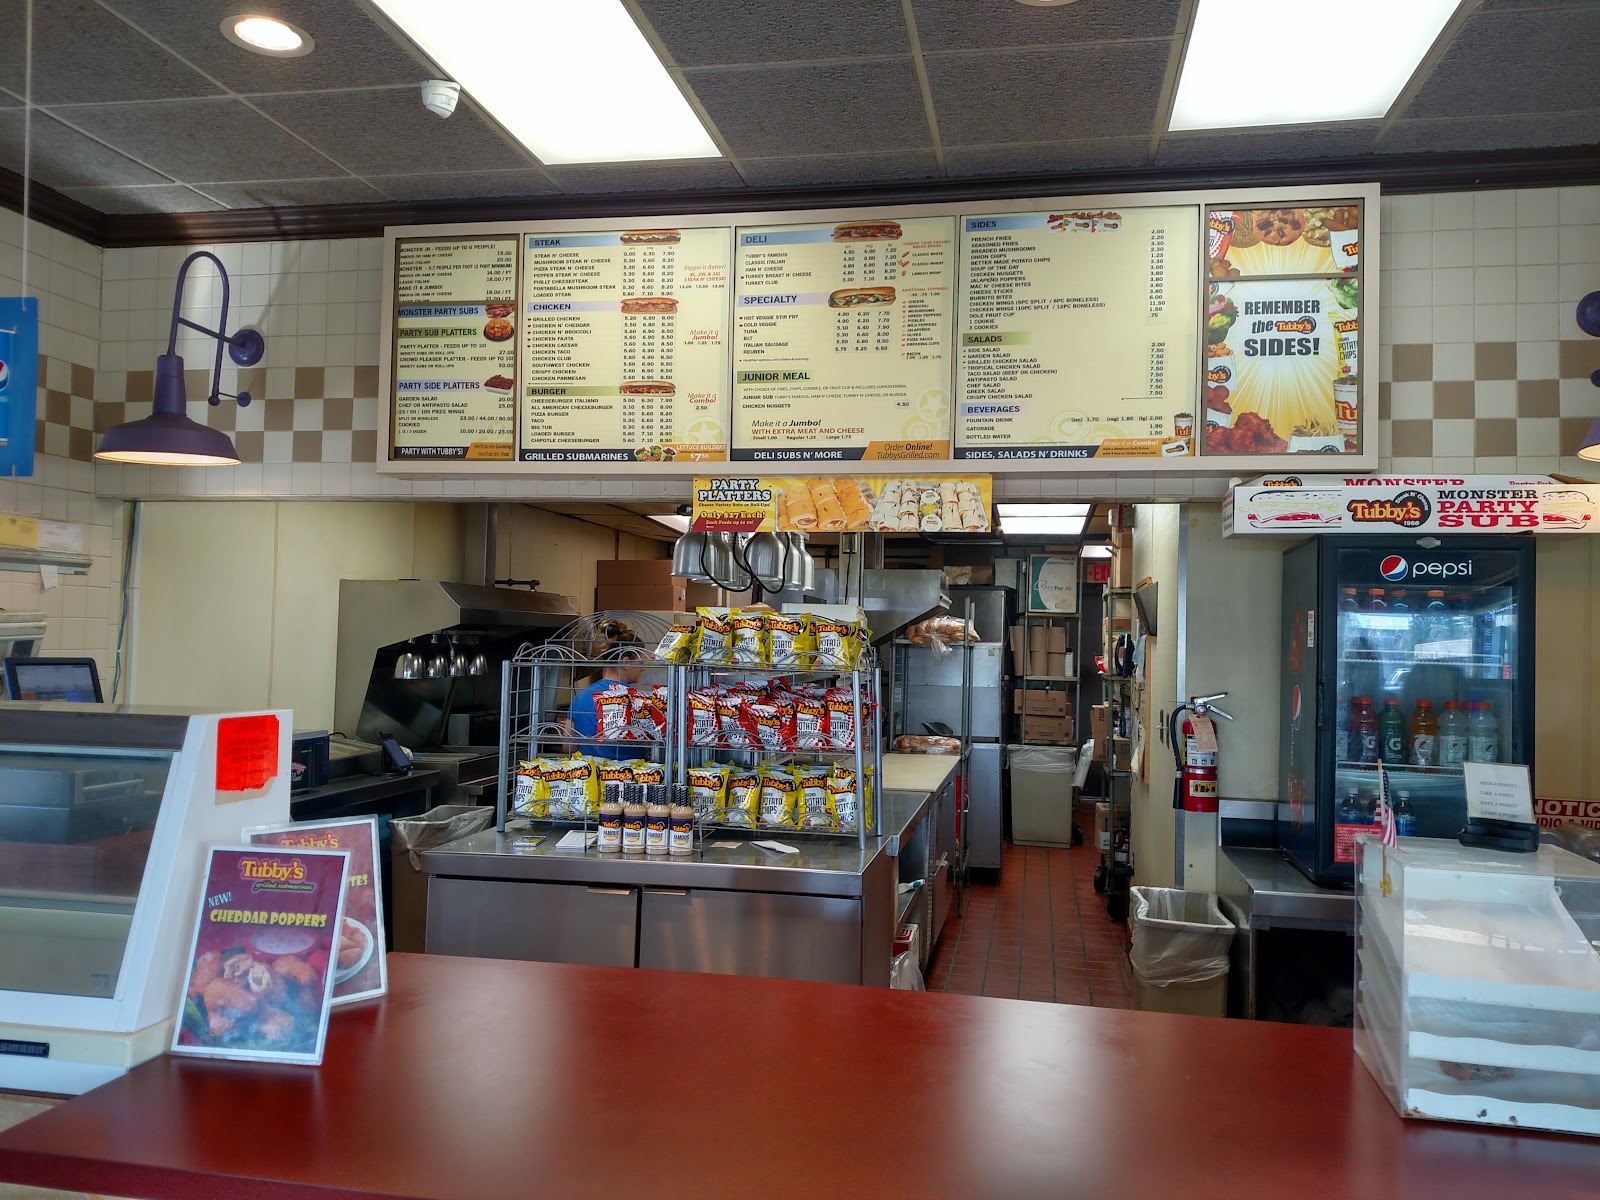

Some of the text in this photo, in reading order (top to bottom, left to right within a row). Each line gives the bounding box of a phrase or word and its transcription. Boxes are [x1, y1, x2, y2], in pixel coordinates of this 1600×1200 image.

[971, 220, 997, 229] SIDES
[745, 235, 767, 243] DELI
[744, 295, 797, 304] SPECIALTY
[399, 308, 432, 316] MONSTER
[1245, 300, 1320, 315] REMEMBER
[1252, 320, 1312, 334] the Tubby's
[442, 328, 477, 336] PLATTERS
[968, 335, 1002, 344] SALADS
[1244, 337, 1320, 357] SIDES!
[743, 372, 810, 381] JUNIOR MEAL
[399, 382, 421, 390] PARTY
[967, 405, 1020, 414] BEVERAGES
[789, 419, 822, 427] Jumbo!
[884, 443, 904, 451] Order
[566, 452, 629, 461] SUBMARINES
[877, 451, 940, 460] TubbysGrilled.com
[965, 451, 996, 460] SIDES,
[997, 450, 1037, 459] SALADS
[1050, 450, 1088, 458] DRINKS
[711, 479, 758, 490] PARTY
[698, 490, 771, 500] PLATTERS
[1438, 490, 1538, 499] MONSTER
[1351, 502, 1421, 520] Tubby's
[1437, 501, 1539, 513] PARTY
[701, 511, 721, 519] Only
[1438, 515, 1539, 527] SUB
[1412, 559, 1473, 578] pepsi
[770, 620, 799, 633] Tubby's
[601, 771, 632, 780] Tubby's
[690, 776, 721, 787] Tubby's
[762, 778, 792, 792] Tubby's
[241, 859, 305, 880] Tubby's
[255, 882, 314, 891] grilled submarines
[208, 891, 232, 908] NEW!
[210, 909, 327, 928] CHEDDAR POPPERS
